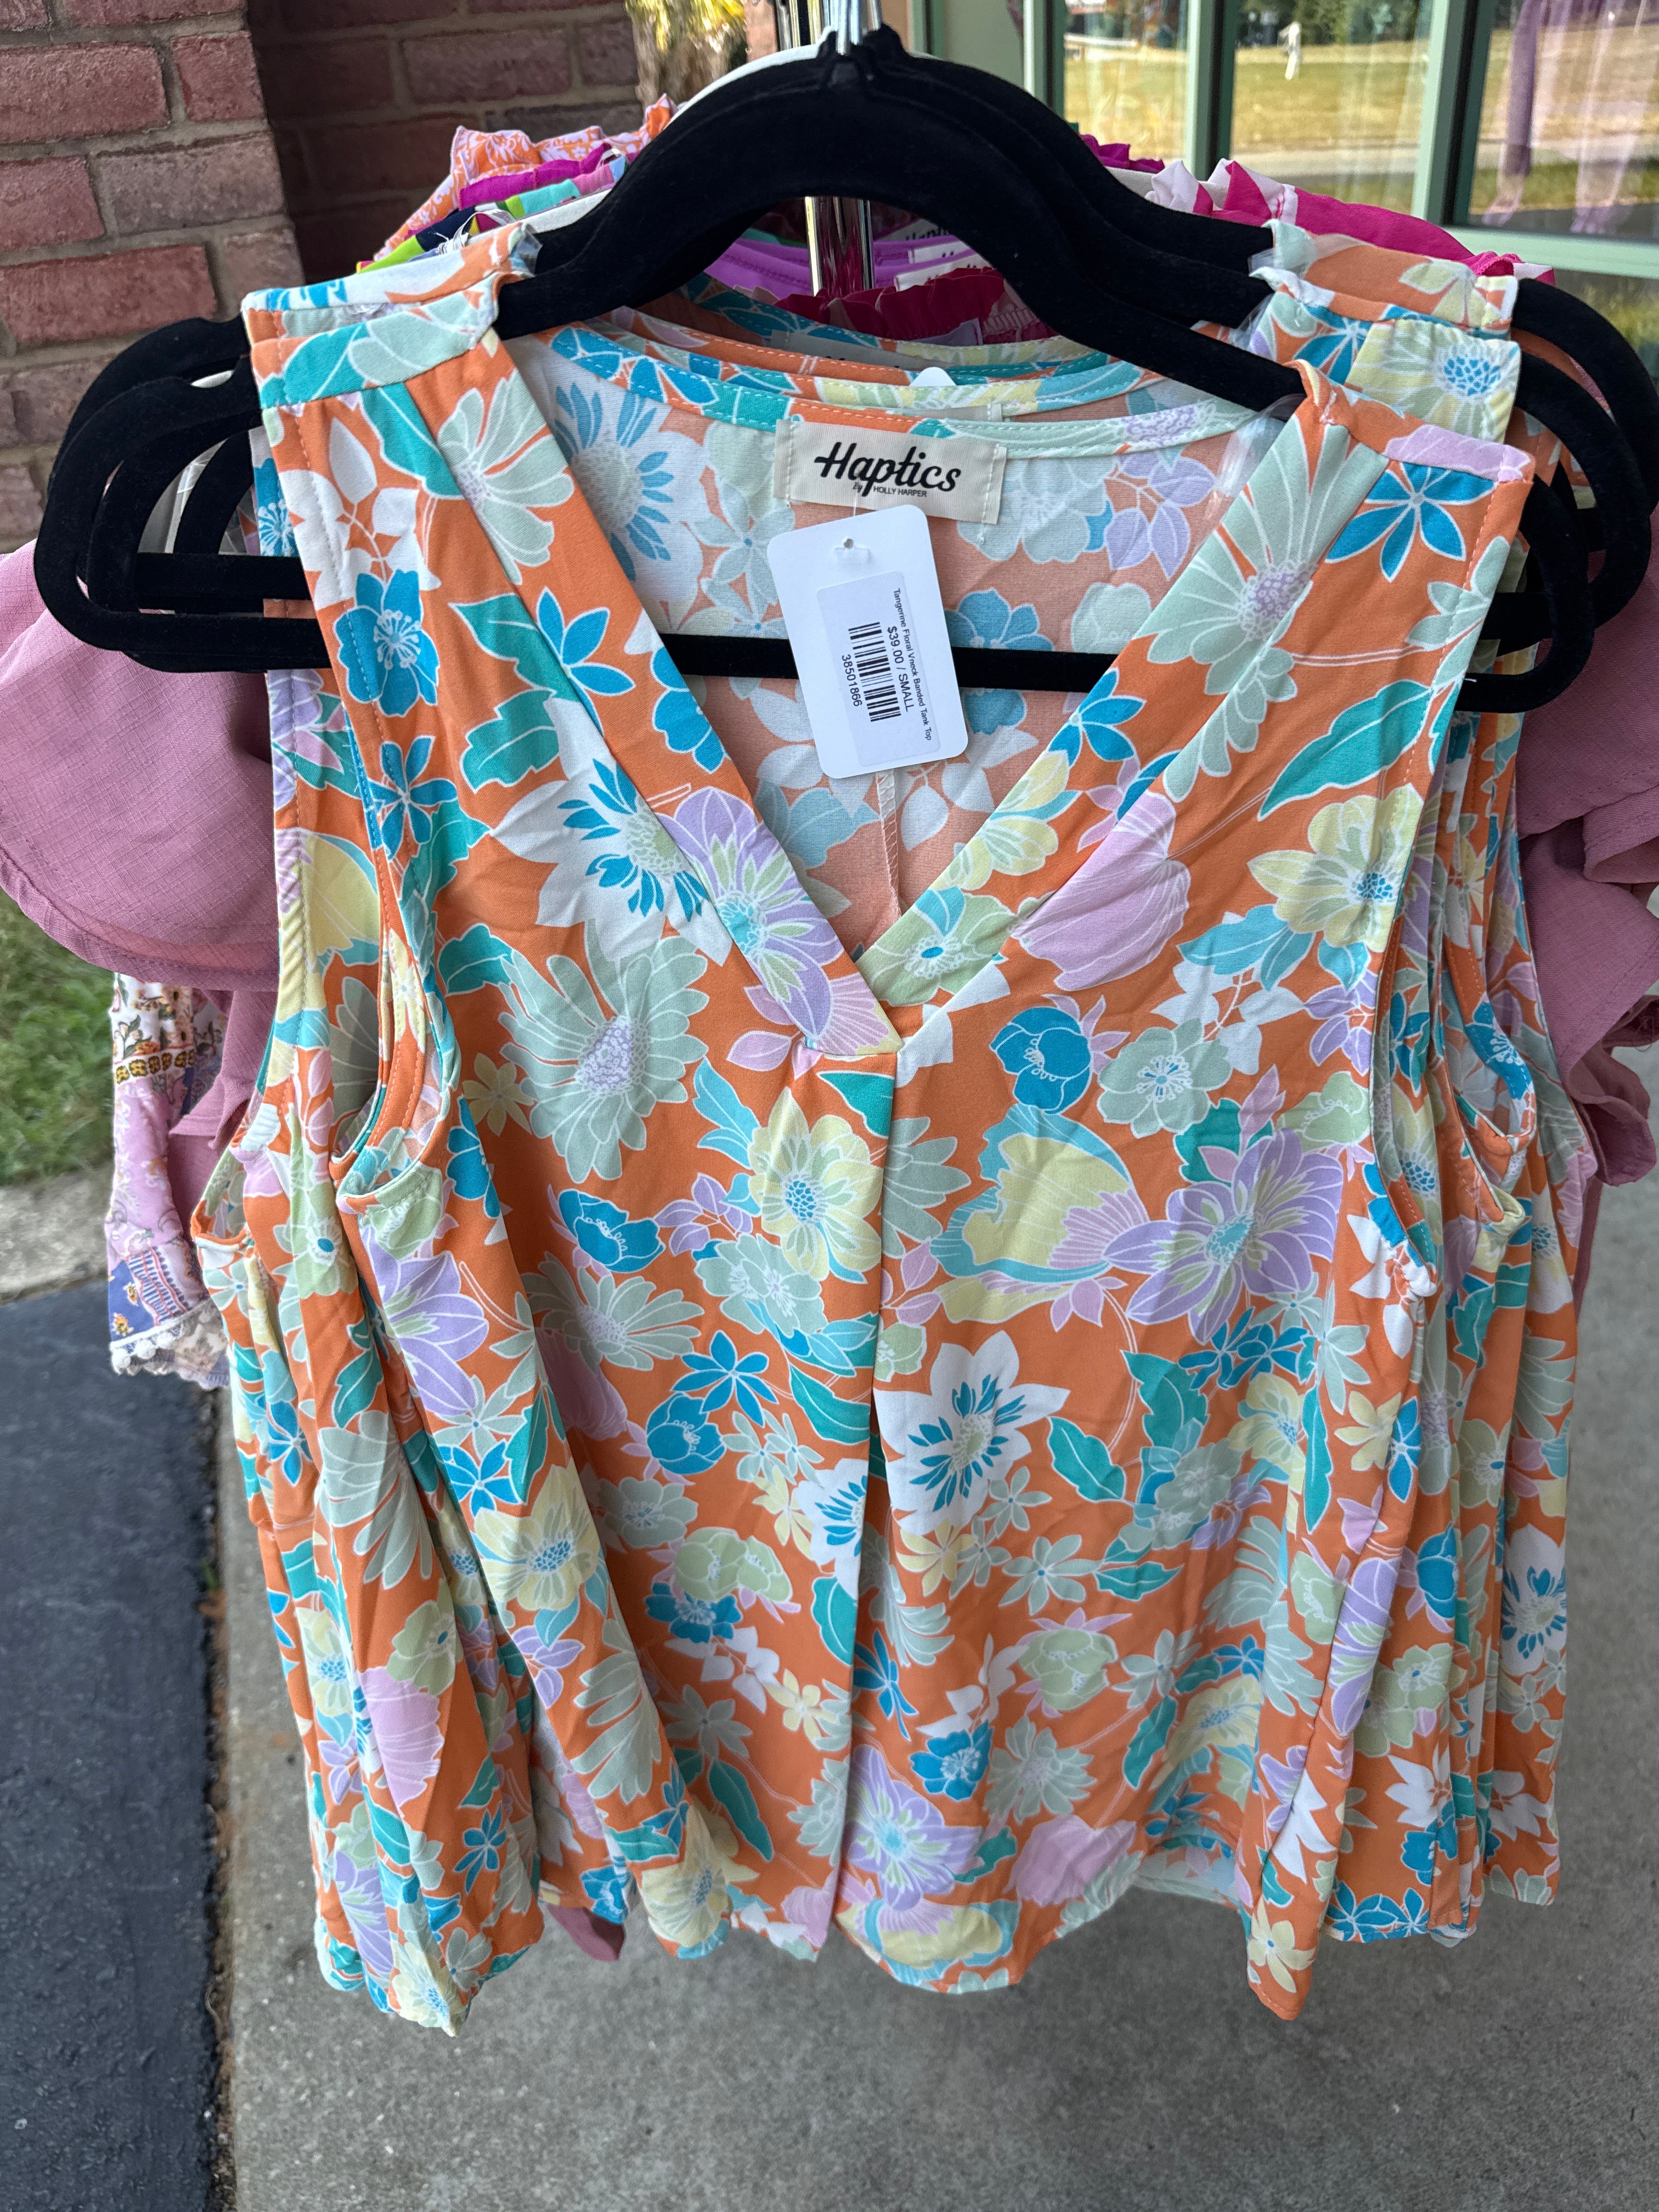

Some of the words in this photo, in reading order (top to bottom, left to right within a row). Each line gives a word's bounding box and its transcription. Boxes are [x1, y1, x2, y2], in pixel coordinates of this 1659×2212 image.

[814, 442, 961, 497] Haptics
[873, 486, 896, 495] HOLLY
[898, 489, 927, 498] HARPER
[842, 654, 862, 707] 38501866
[887, 626, 904, 664] $39.00
[899, 674, 915, 712] SMALL
[894, 588, 906, 627] Tangerine
[902, 629, 913, 651] Floral
[908, 652, 918, 676] Vneck
[913, 678, 926, 707] Banded
[921, 708, 929, 726] Tank
